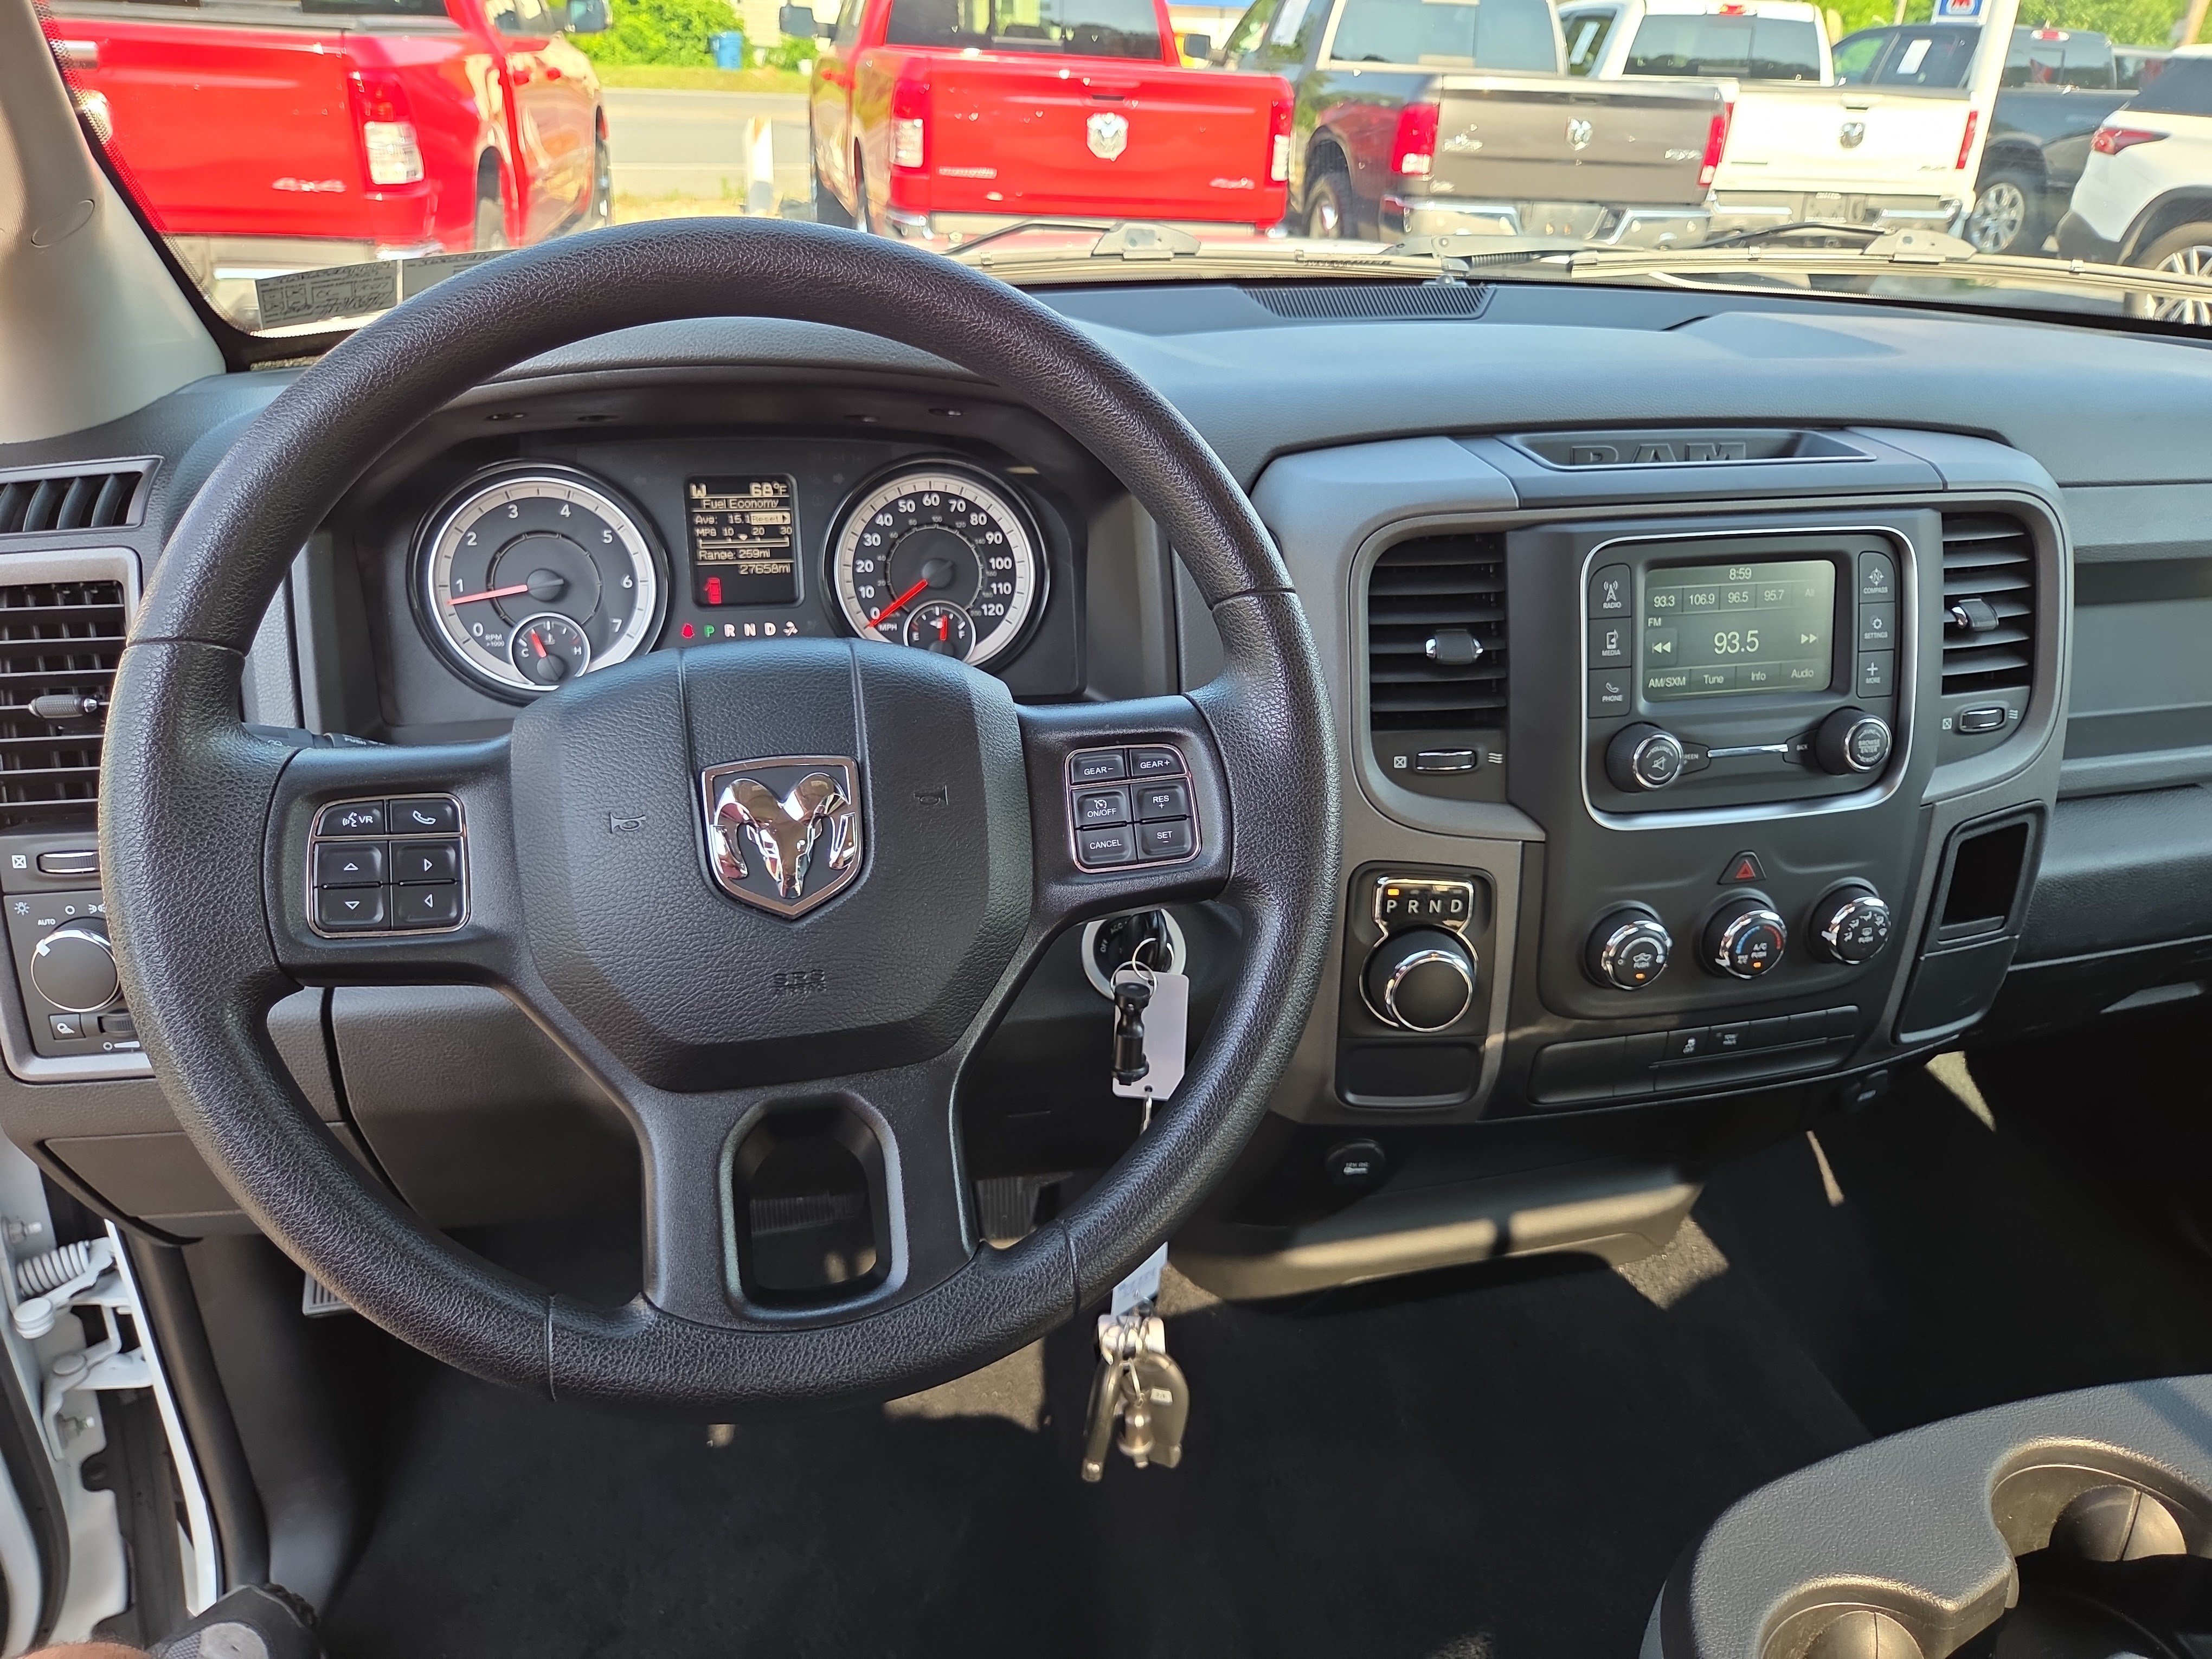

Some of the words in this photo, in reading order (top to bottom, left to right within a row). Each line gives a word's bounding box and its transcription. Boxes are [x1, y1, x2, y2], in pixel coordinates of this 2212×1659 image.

[690, 483, 706, 497] W
[702, 498, 726, 509] Fuel
[729, 498, 779, 509] Economy
[898, 499, 916, 513] 50
[922, 493, 940, 506] 60
[948, 499, 966, 513] 70
[507, 504, 519, 519] 3
[560, 504, 572, 518] 4
[694, 515, 718, 525] Avg:
[728, 514, 751, 524] 15.1
[875, 513, 893, 527] 40
[969, 513, 987, 526] 80
[602, 529, 614, 544] 5
[695, 527, 717, 537] MPG
[722, 526, 735, 536] 10
[751, 526, 765, 536] 20
[780, 526, 793, 535] 30
[985, 531, 1003, 545] 90
[467, 531, 478, 546] 2
[863, 533, 881, 546] 30
[698, 550, 736, 561] Range:
[856, 560, 874, 573] 20
[989, 557, 1012, 570] 100
[1729, 567, 1752, 581] 8:59
[455, 578, 464, 593] 1
[621, 575, 633, 588] 6
[859, 586, 874, 599] 10
[991, 582, 1012, 595] 110
[1654, 595, 1675, 608] 93.3
[1689, 593, 1715, 606] 106.9
[1728, 591, 1749, 603] 96.5
[1764, 589, 1785, 602] 95.7
[1805, 588, 1815, 597] All
[870, 607, 880, 620] 0
[981, 603, 1004, 616] 120
[612, 618, 622, 633] 7
[878, 623, 897, 631] MPH
[1648, 617, 1662, 627] FM
[473, 622, 484, 637] 0
[705, 625, 715, 638] P
[724, 623, 736, 638] R
[744, 623, 756, 636] N
[764, 622, 776, 636] D
[958, 631, 965, 639] F
[912, 632, 919, 641] E
[1714, 629, 1759, 654] 93.5
[521, 648, 529, 658] C
[574, 646, 582, 655] H
[1648, 676, 1686, 689] AM/SXM
[1703, 674, 1724, 685] Tune
[1751, 671, 1766, 681] Info
[1791, 668, 1815, 679] Audio
[1602, 695, 1622, 703] PHONE
[1140, 759, 1171, 769] GEAR+
[1152, 795, 1169, 804] RES
[358, 815, 374, 824] VR
[1086, 808, 1117, 818] ON/OFF
[1156, 831, 1173, 839] SET
[1090, 839, 1122, 850] CANCEL
[1386, 899, 1398, 914] P
[1408, 899, 1420, 914] R
[1429, 899, 1442, 914] N
[1450, 899, 1463, 913] D
[37, 918, 56, 926] AUTO
